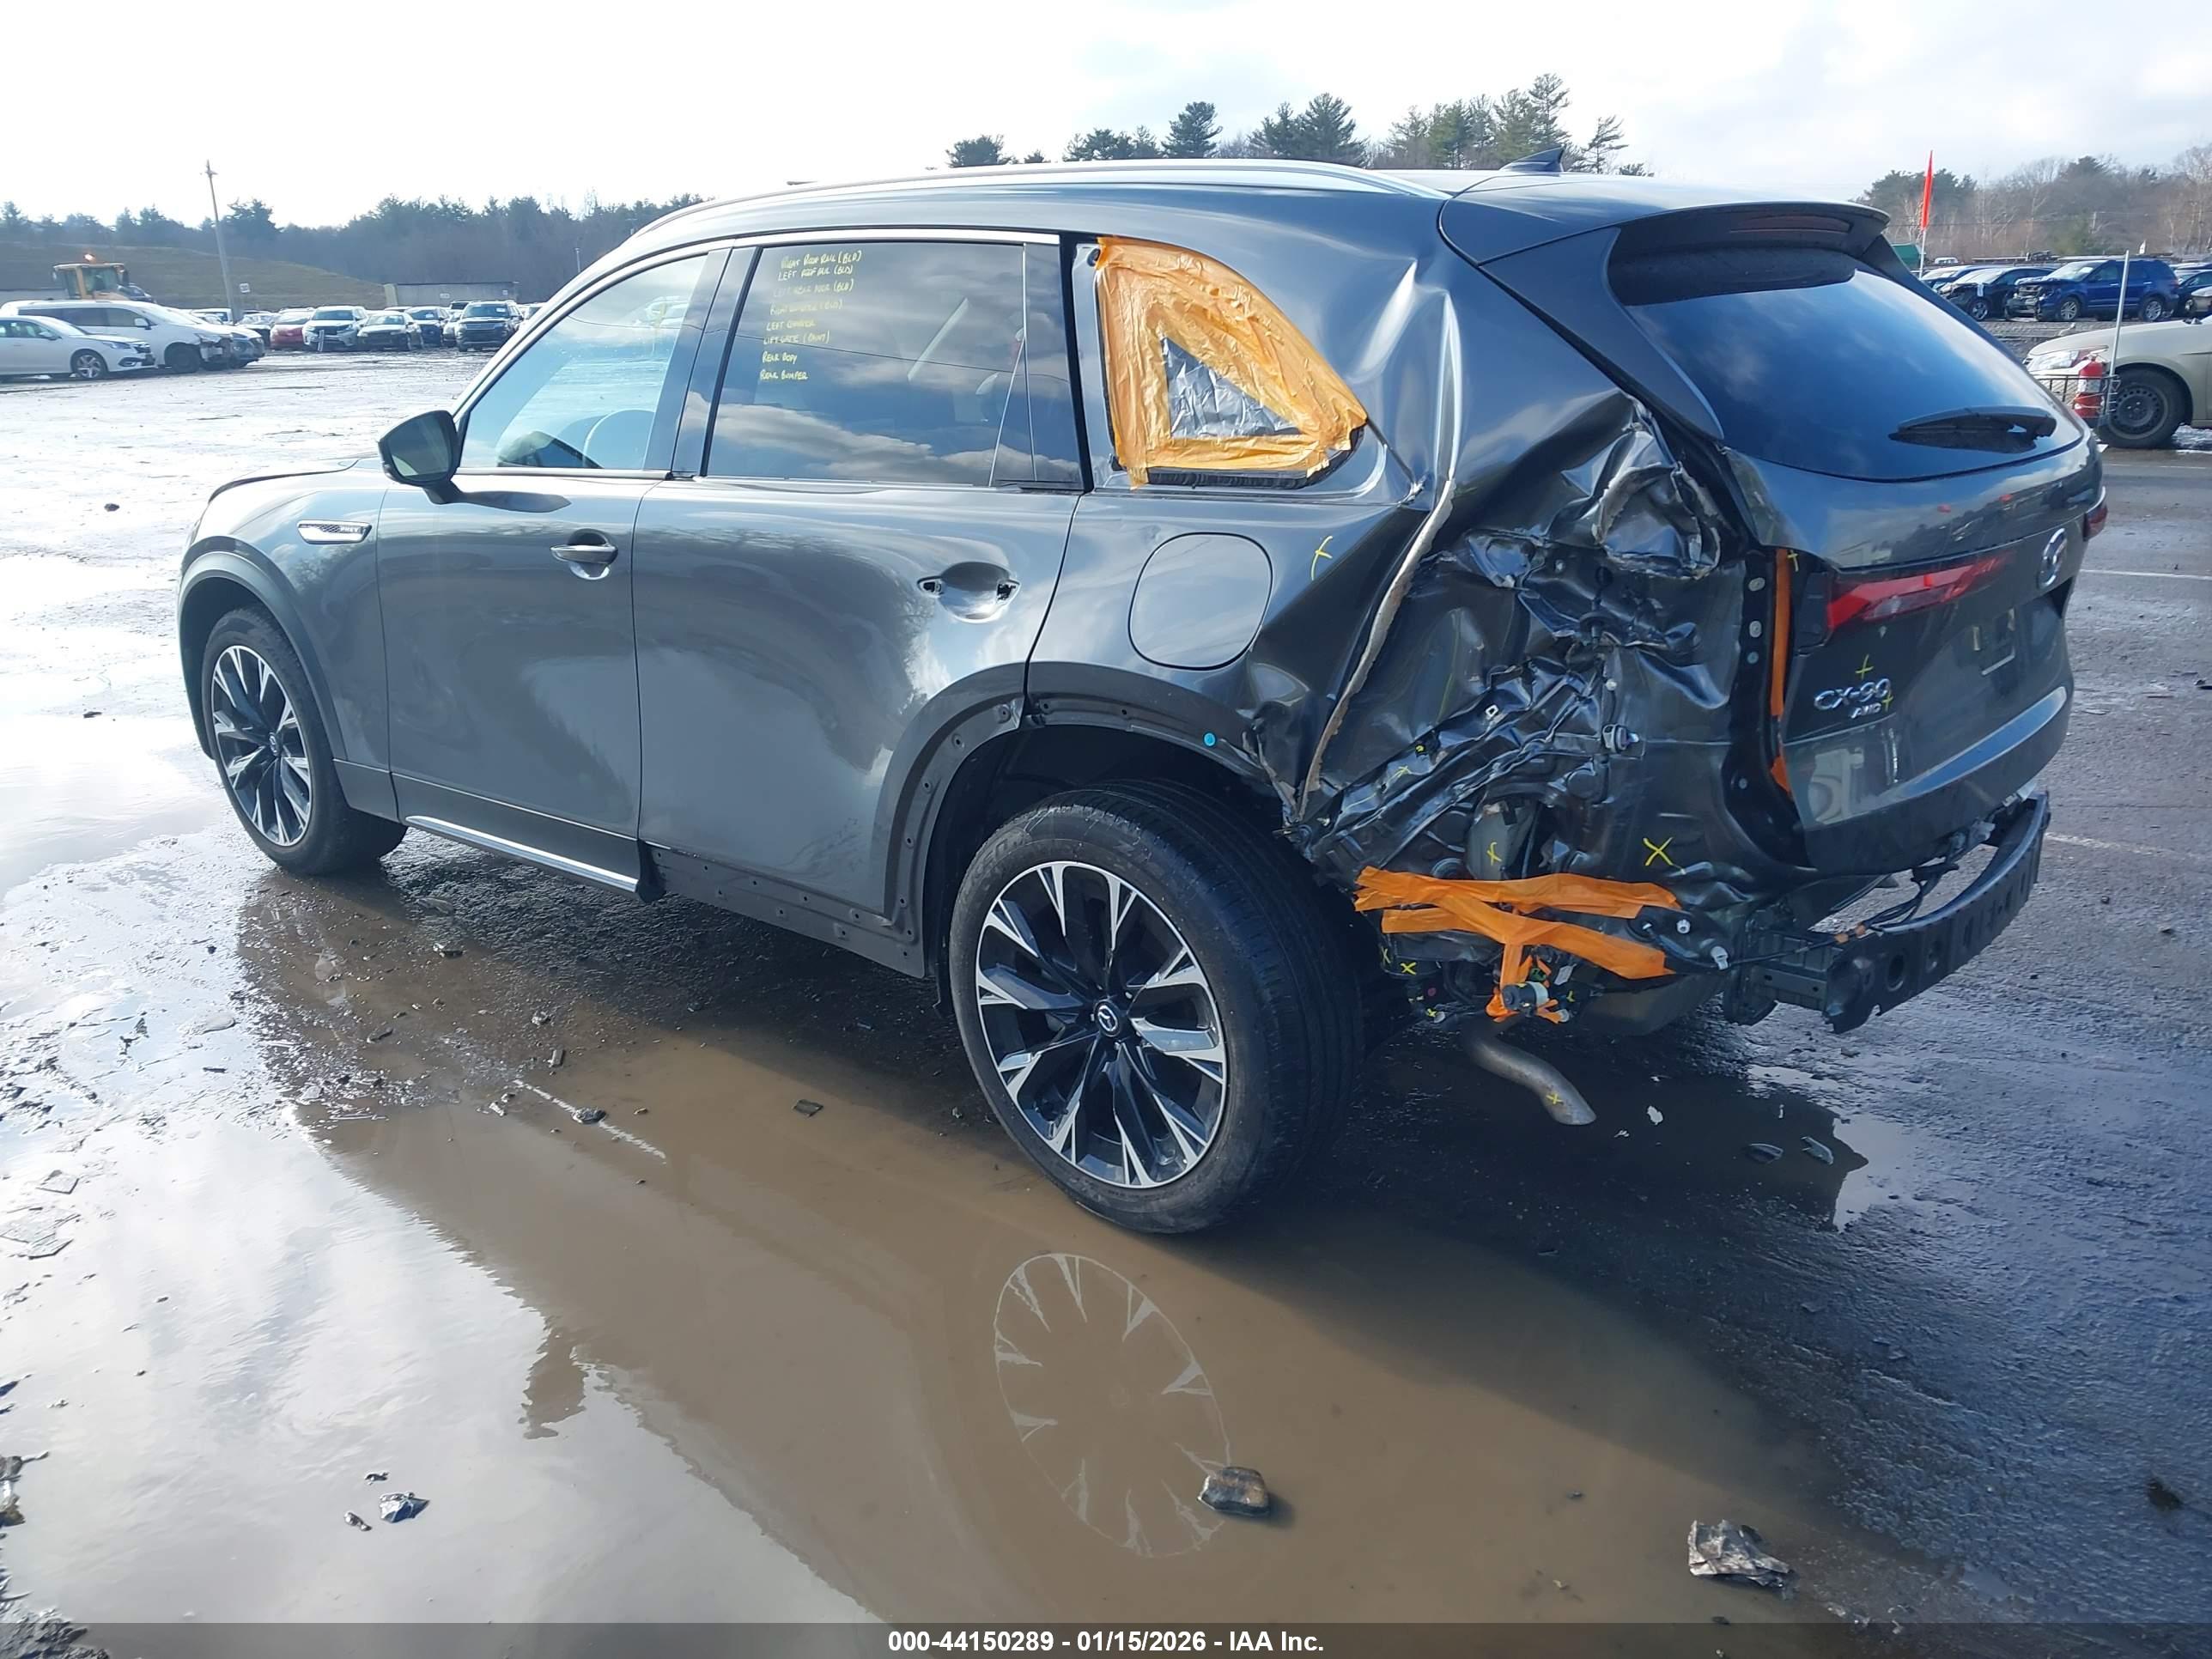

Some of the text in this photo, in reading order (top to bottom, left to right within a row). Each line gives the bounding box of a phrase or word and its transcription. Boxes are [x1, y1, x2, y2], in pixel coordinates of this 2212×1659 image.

[777, 270, 798, 282] LEFT
[1814, 678, 1892, 711] CX-90
[1850, 702, 1883, 720] AWD
